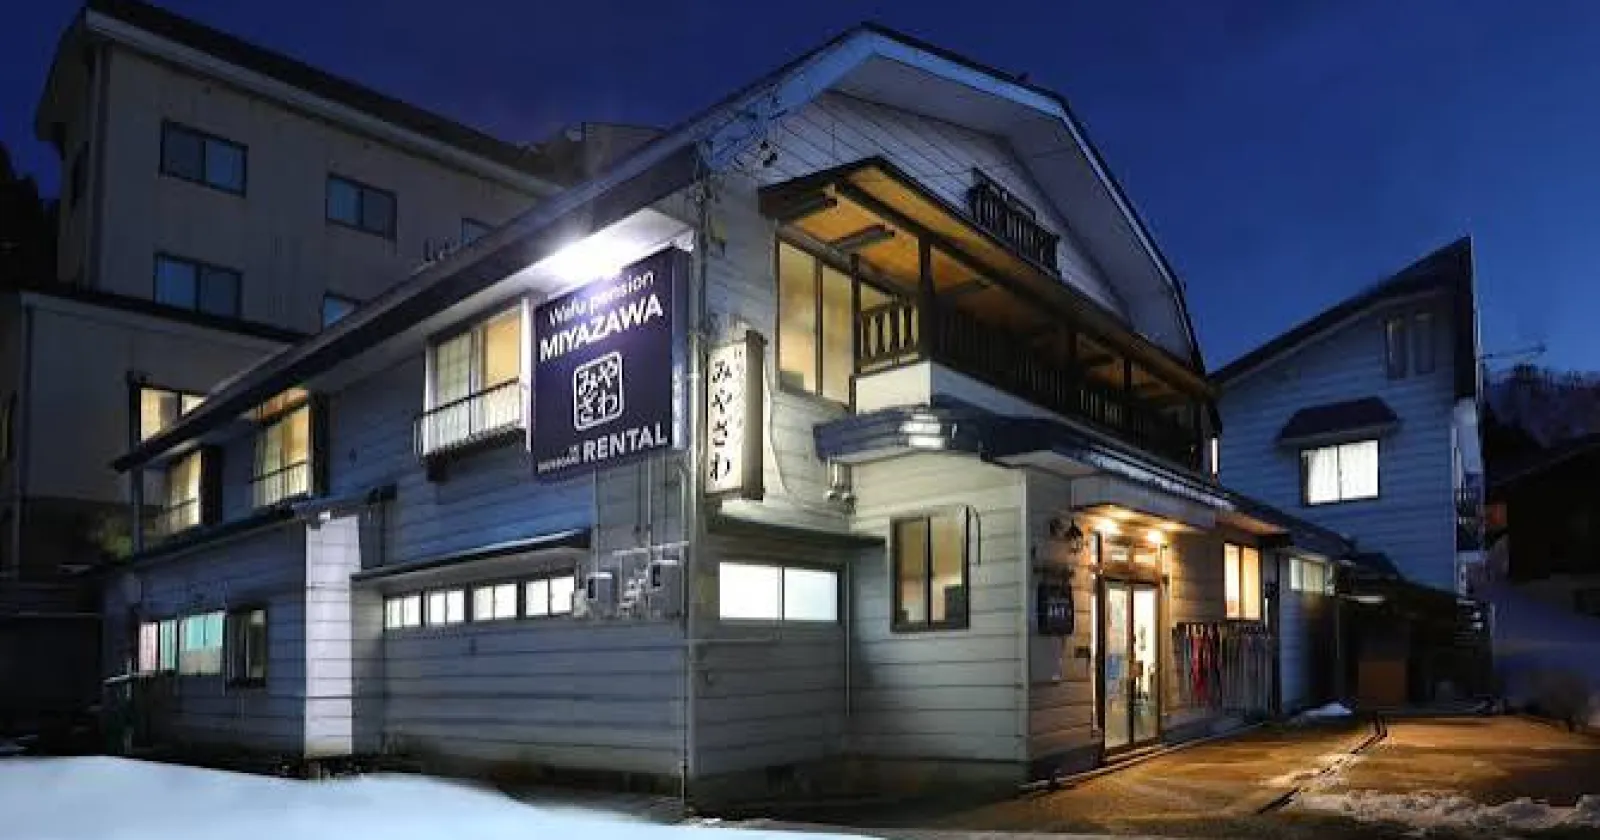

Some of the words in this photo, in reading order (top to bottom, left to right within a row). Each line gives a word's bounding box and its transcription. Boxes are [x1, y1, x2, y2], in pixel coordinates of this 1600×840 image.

[540, 294, 663, 362] MIYAZAWA
[583, 422, 668, 463] RENTAL
[710, 361, 732, 482] みやざわ
